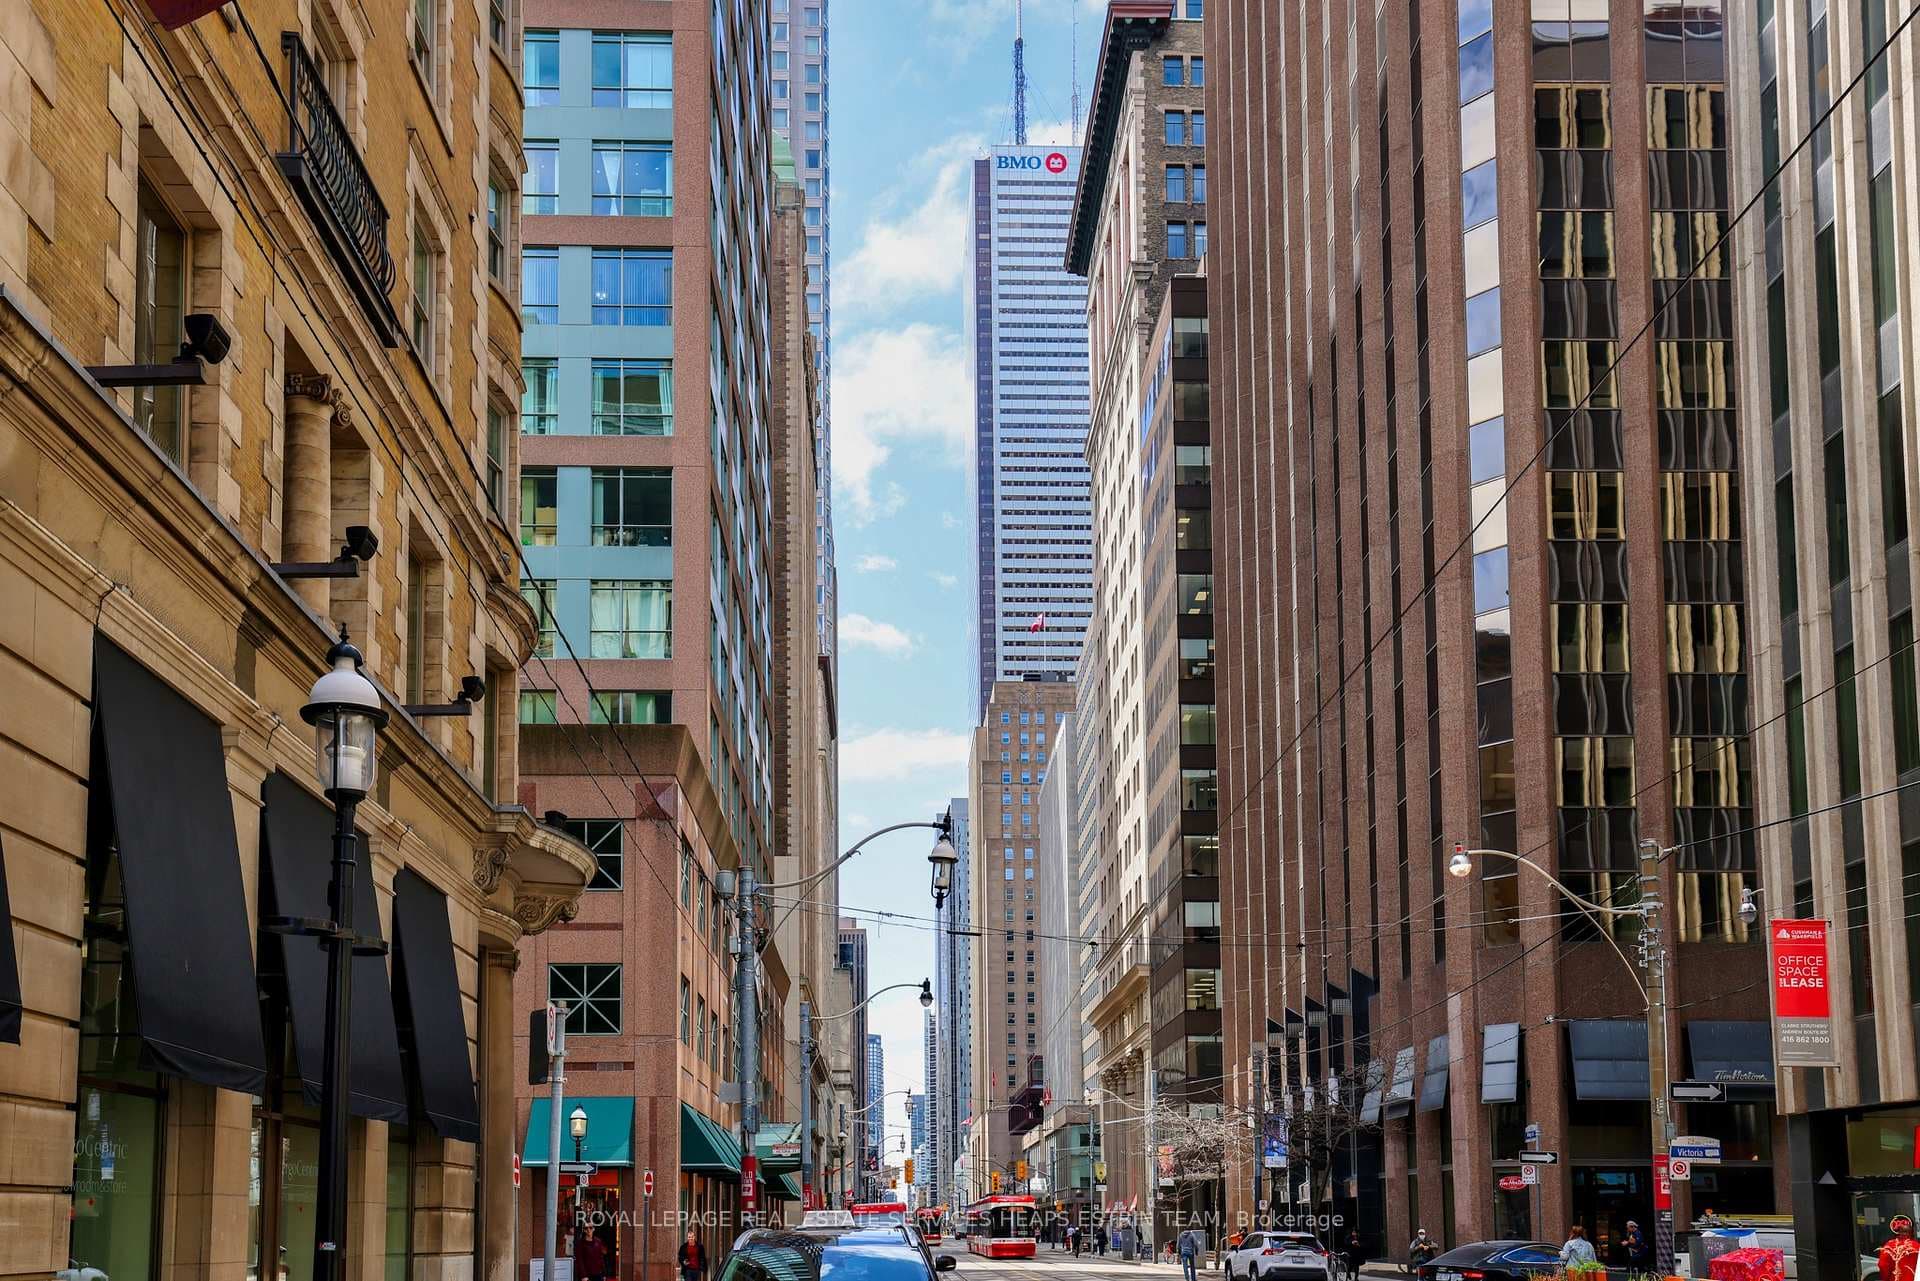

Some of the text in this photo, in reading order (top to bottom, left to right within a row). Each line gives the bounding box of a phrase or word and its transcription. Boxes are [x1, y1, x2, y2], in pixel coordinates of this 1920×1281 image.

[997, 156, 1041, 169] BMO
[1778, 955, 1824, 966] OFFICE
[1778, 966, 1819, 977] SPACE
[1783, 978, 1824, 988] LEASE
[1678, 1147, 1704, 1157] Victoria
